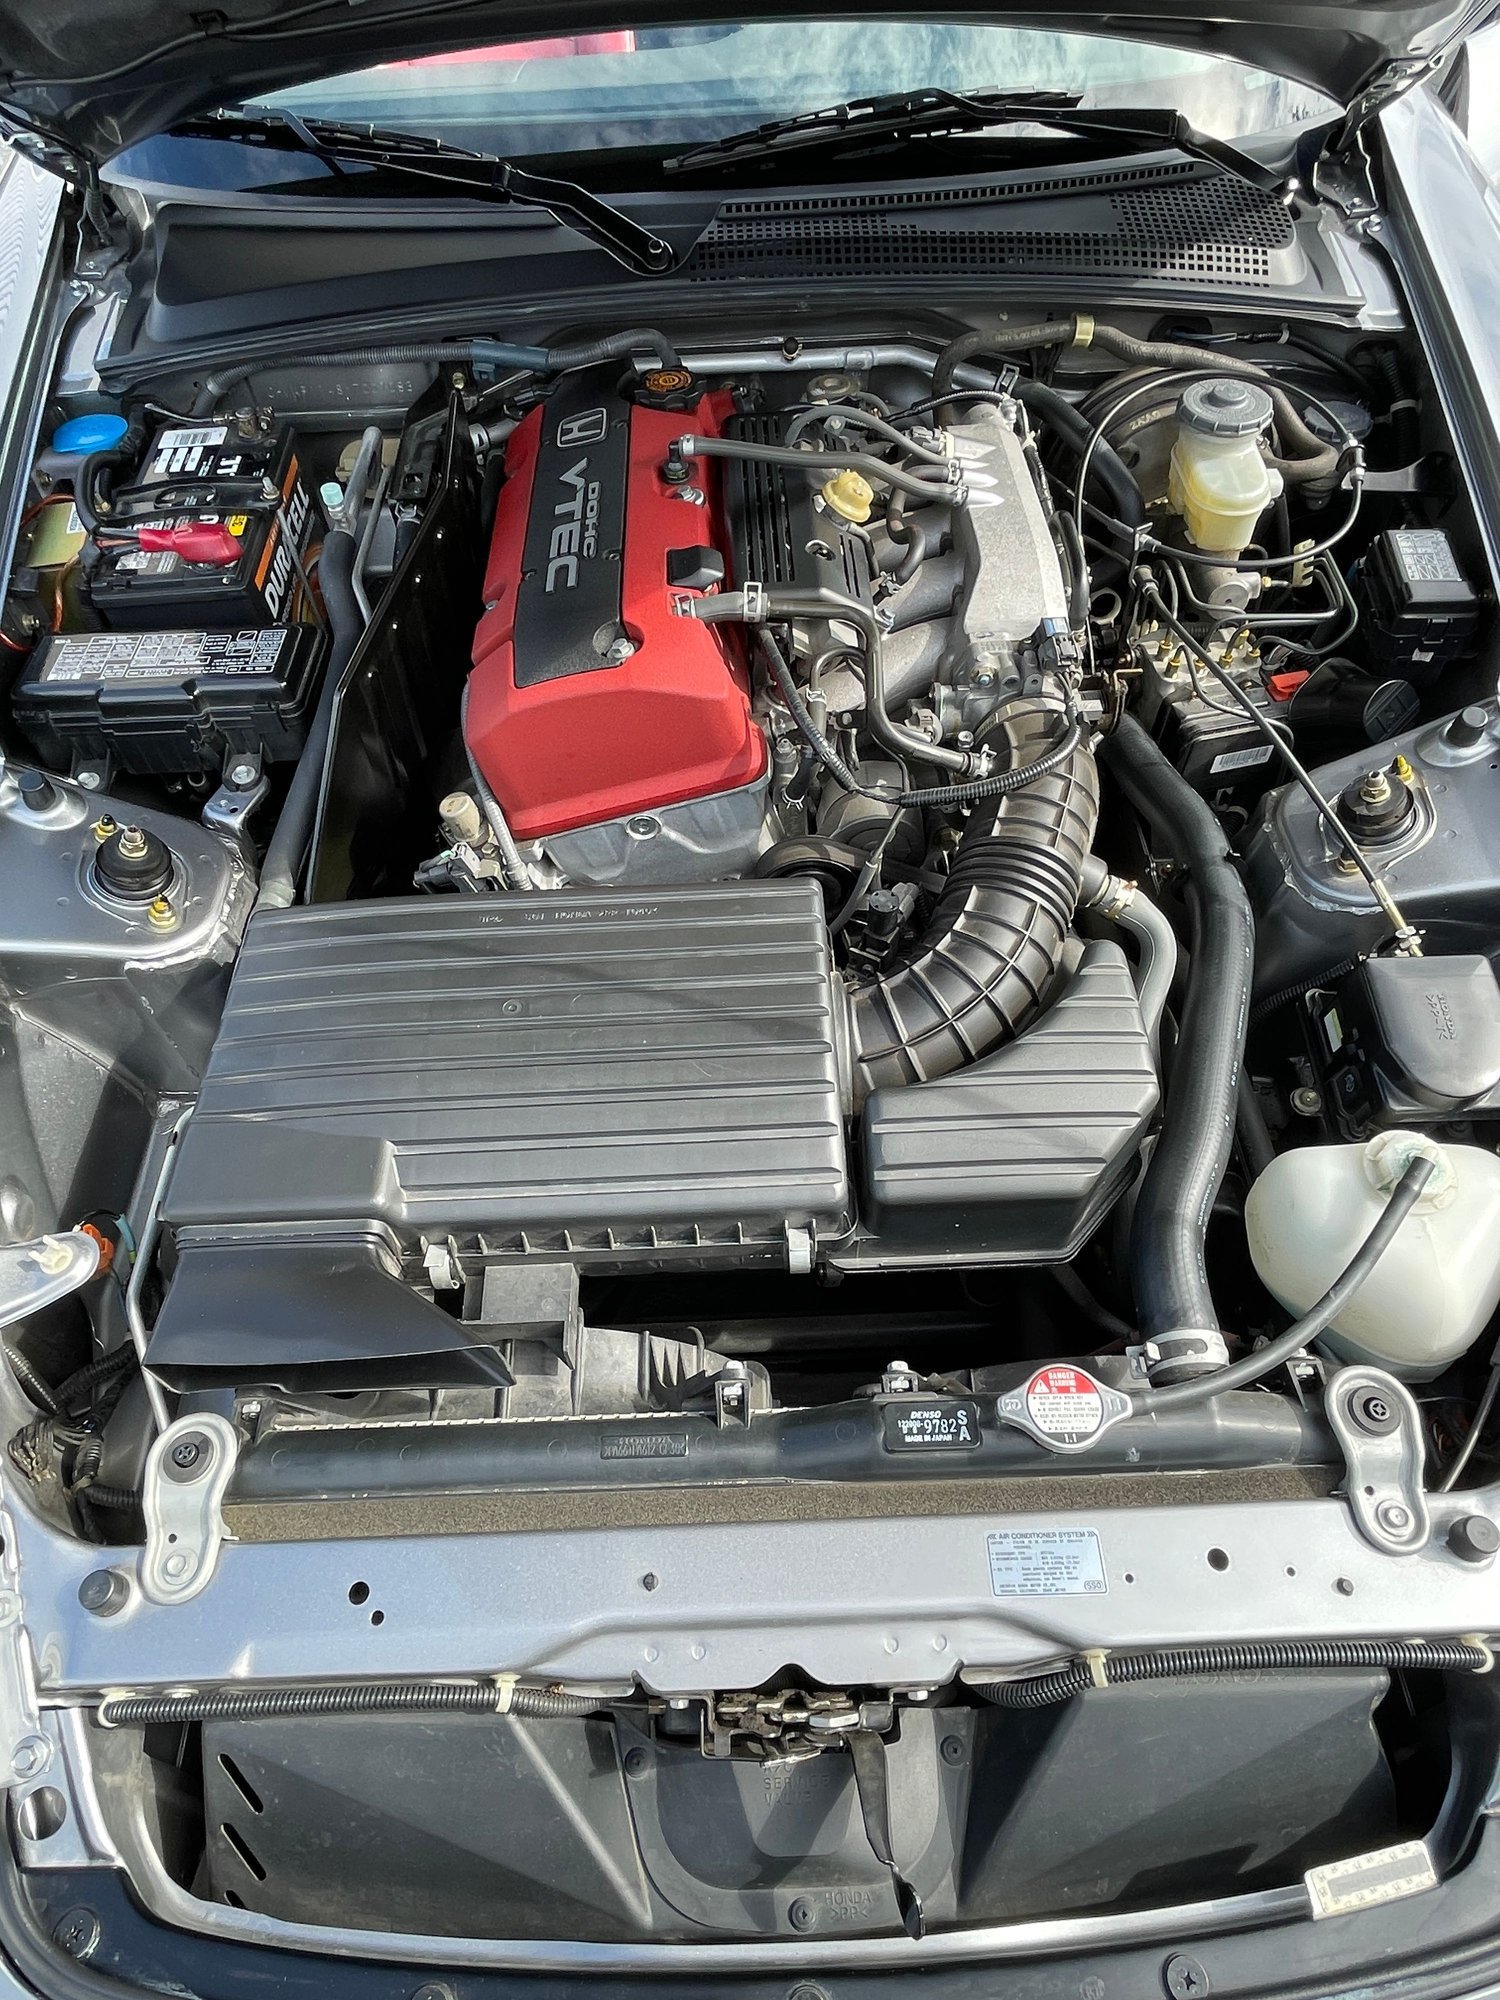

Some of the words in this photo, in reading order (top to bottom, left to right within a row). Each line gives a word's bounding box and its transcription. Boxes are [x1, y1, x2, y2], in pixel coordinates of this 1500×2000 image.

[545, 457, 588, 593] VTEC
[583, 481, 600, 559] DOHC
[910, 1410, 942, 1419] DENSO
[957, 1409, 968, 1425] S
[959, 1425, 971, 1441] A
[763, 1776, 831, 1790] SERVICE
[824, 1891, 873, 1906] HONDA
